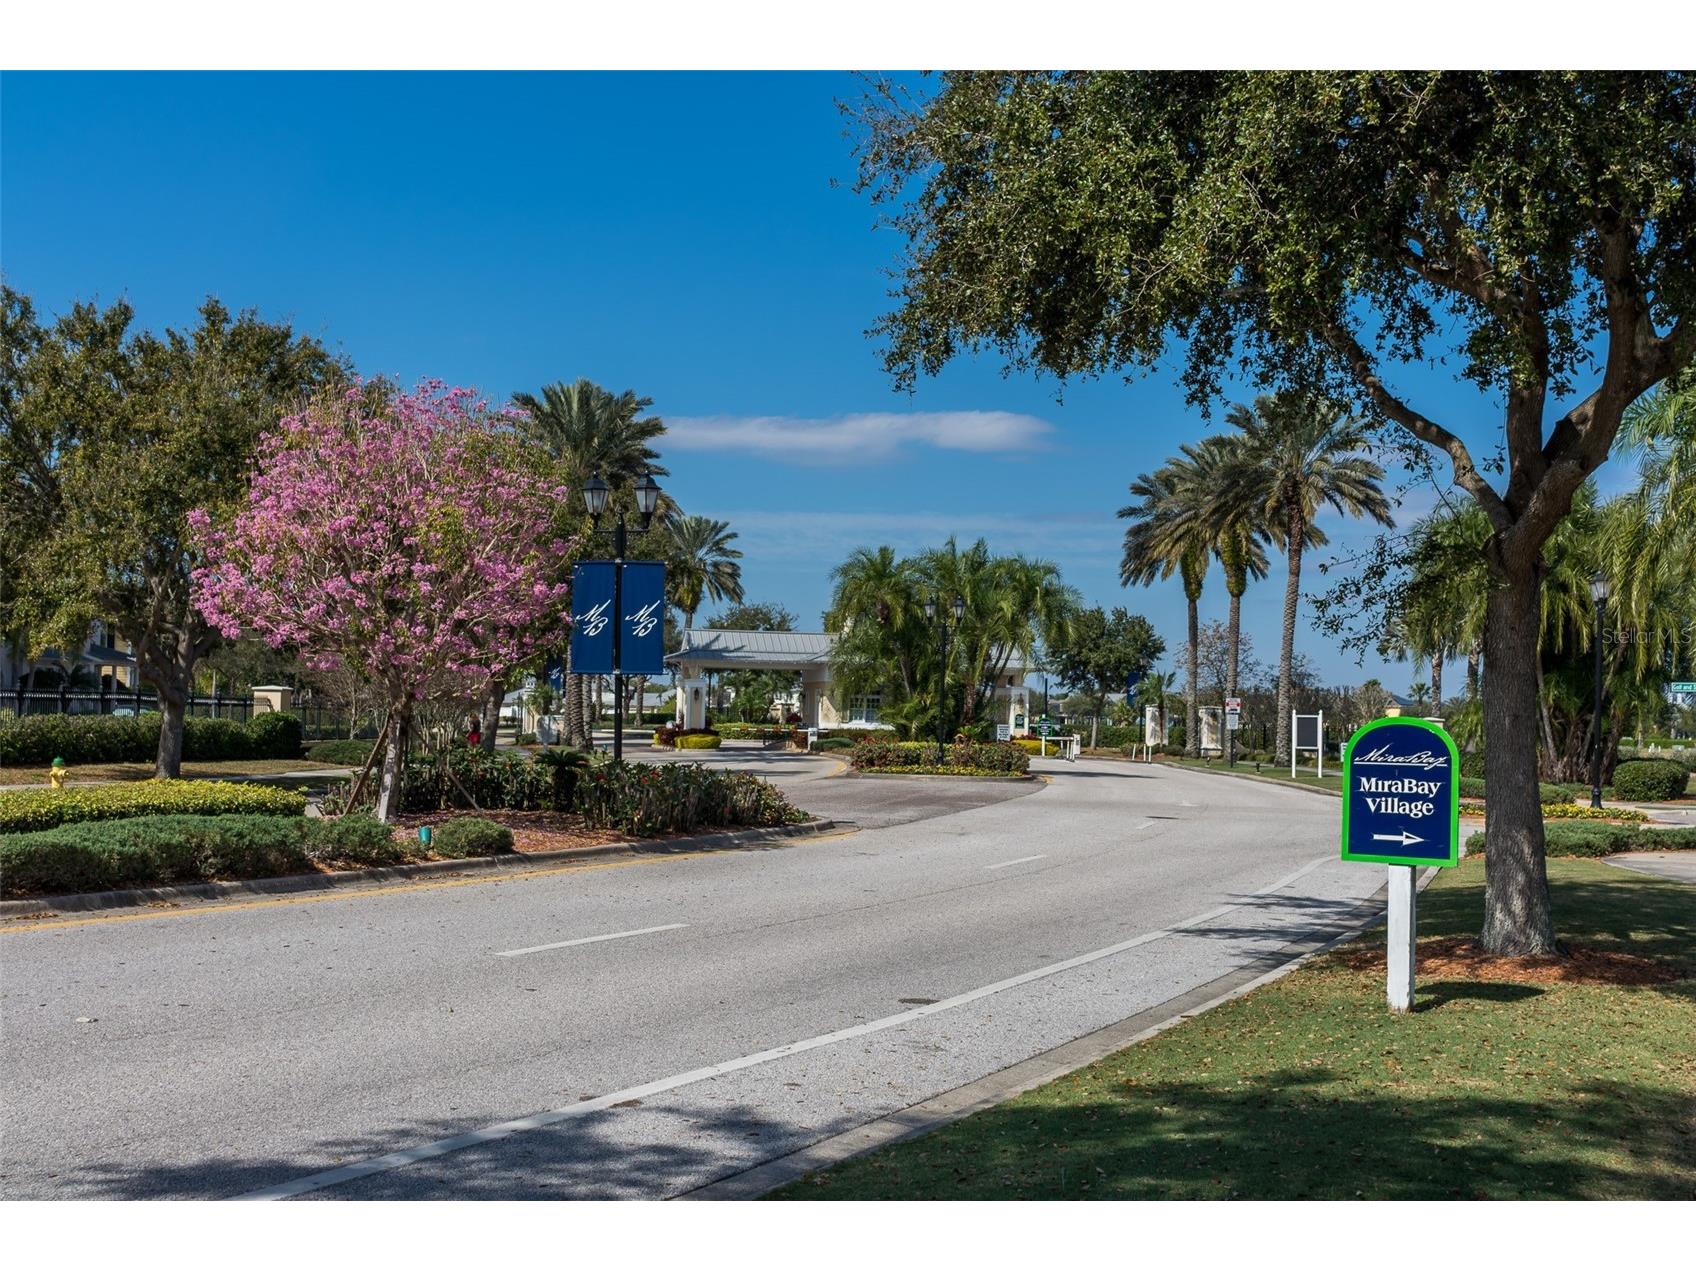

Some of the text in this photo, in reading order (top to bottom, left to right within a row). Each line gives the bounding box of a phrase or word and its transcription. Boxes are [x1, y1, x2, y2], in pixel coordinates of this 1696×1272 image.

[1354, 743, 1447, 770] MiraBay
[1360, 777, 1441, 797] MiraBay
[1366, 797, 1434, 818] Village
